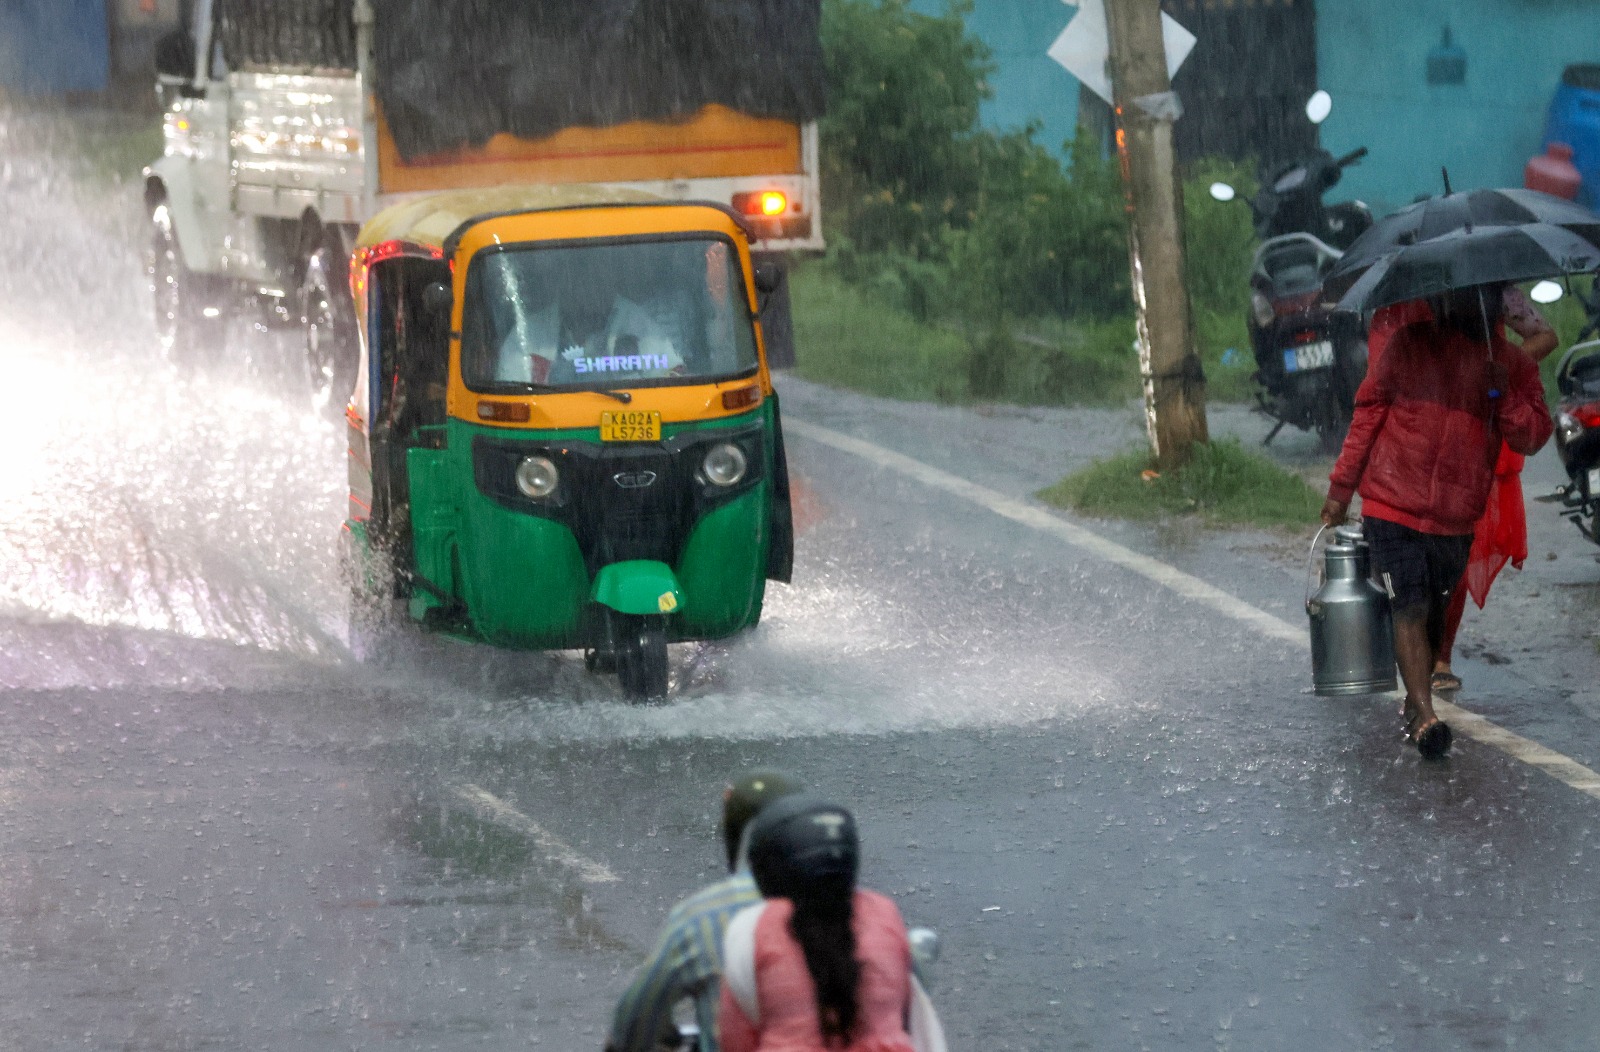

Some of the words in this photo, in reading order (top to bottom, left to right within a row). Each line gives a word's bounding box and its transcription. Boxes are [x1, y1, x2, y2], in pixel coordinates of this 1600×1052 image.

[573, 354, 669, 373] SHARATH
[611, 413, 653, 425] KA02A
[611, 427, 653, 439] L5736
